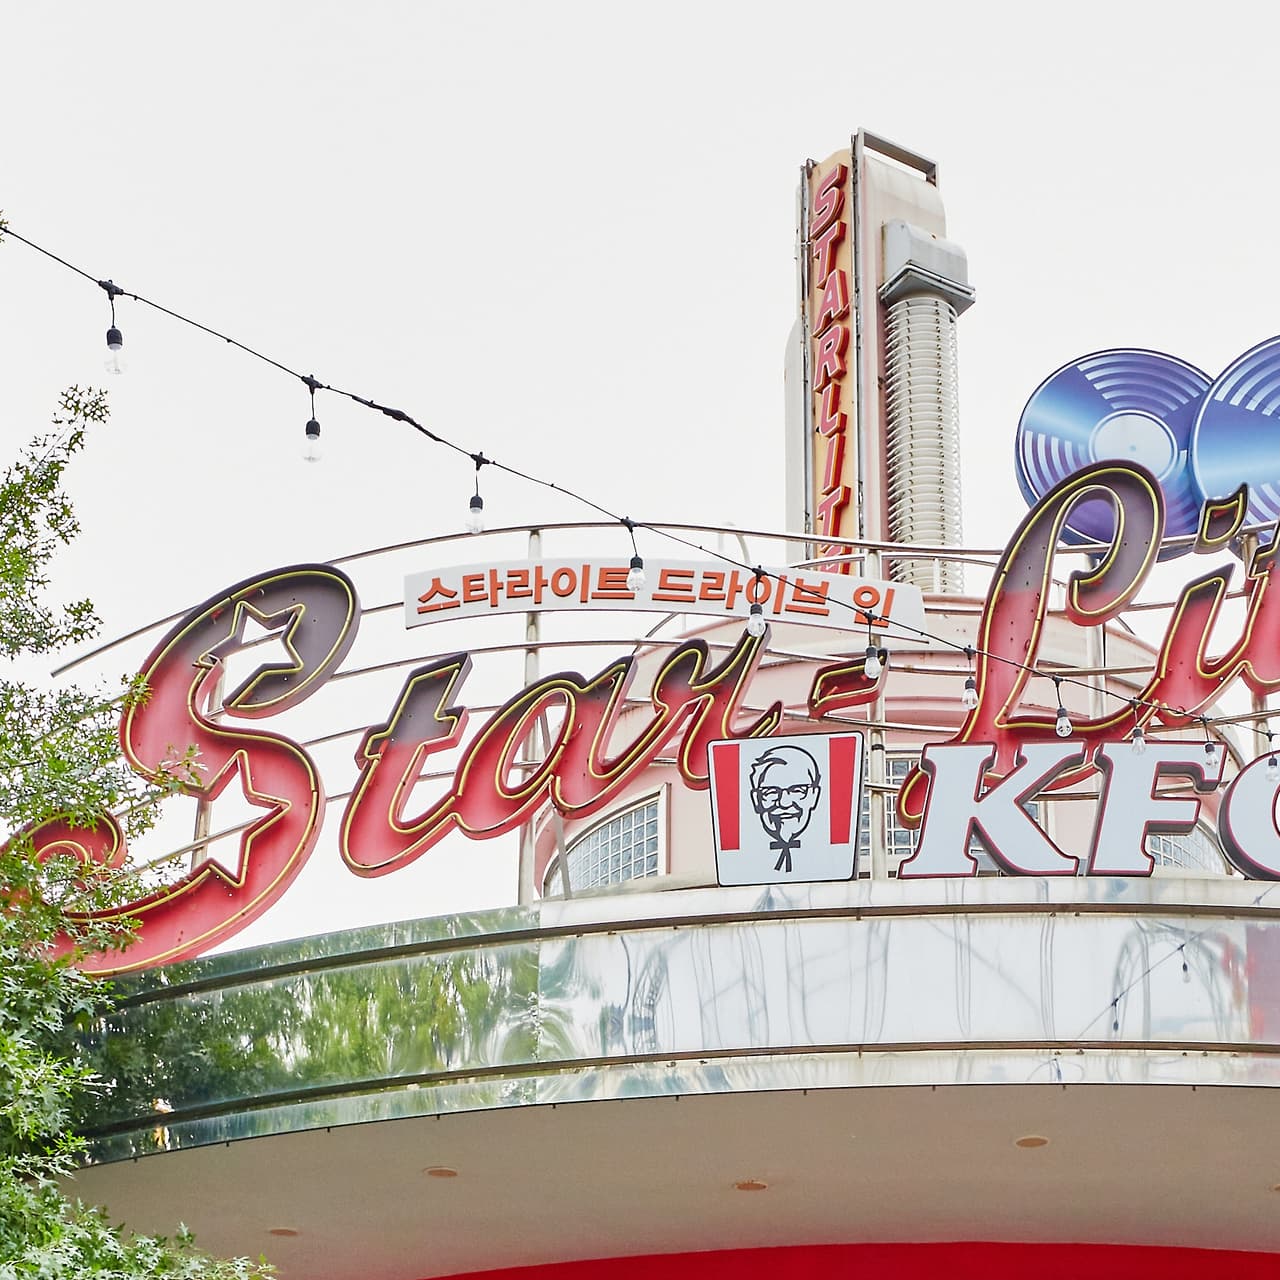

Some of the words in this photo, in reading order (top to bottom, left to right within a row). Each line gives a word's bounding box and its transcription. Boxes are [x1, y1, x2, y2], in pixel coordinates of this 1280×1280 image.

[417, 563, 636, 615] 스타라이트
[651, 568, 830, 617] 드라이브
[852, 586, 895, 629] 인
